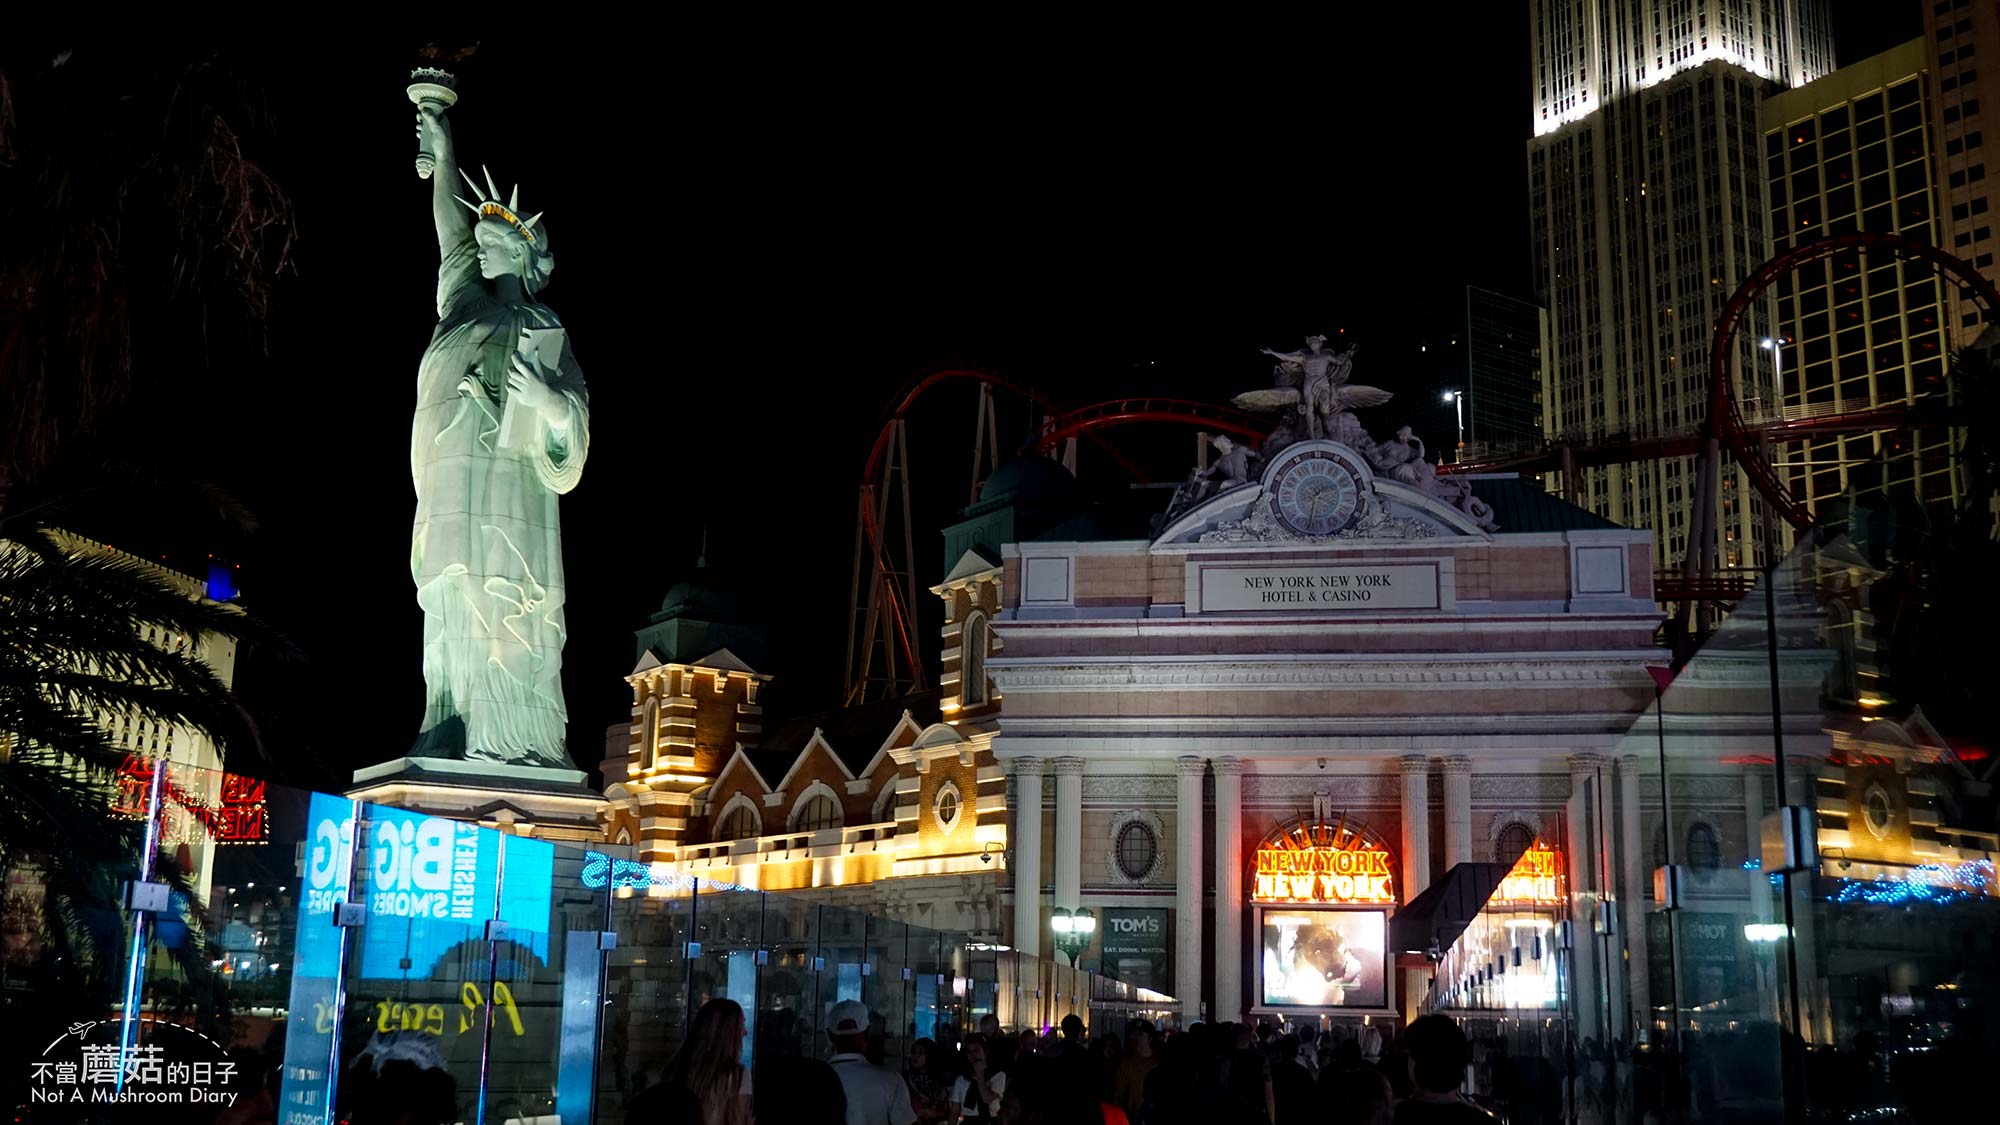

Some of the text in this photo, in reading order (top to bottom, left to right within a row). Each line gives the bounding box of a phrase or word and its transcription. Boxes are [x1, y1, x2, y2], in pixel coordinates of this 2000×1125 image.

[1245, 575, 1391, 588] NEW YORK NEW YORK
[1262, 590, 1371, 602] HOTEL & CASINO
[1258, 850, 1390, 874] NEW YORK
[1257, 874, 1391, 899] NEW YORK
[1110, 916, 1160, 932] TOM'S
